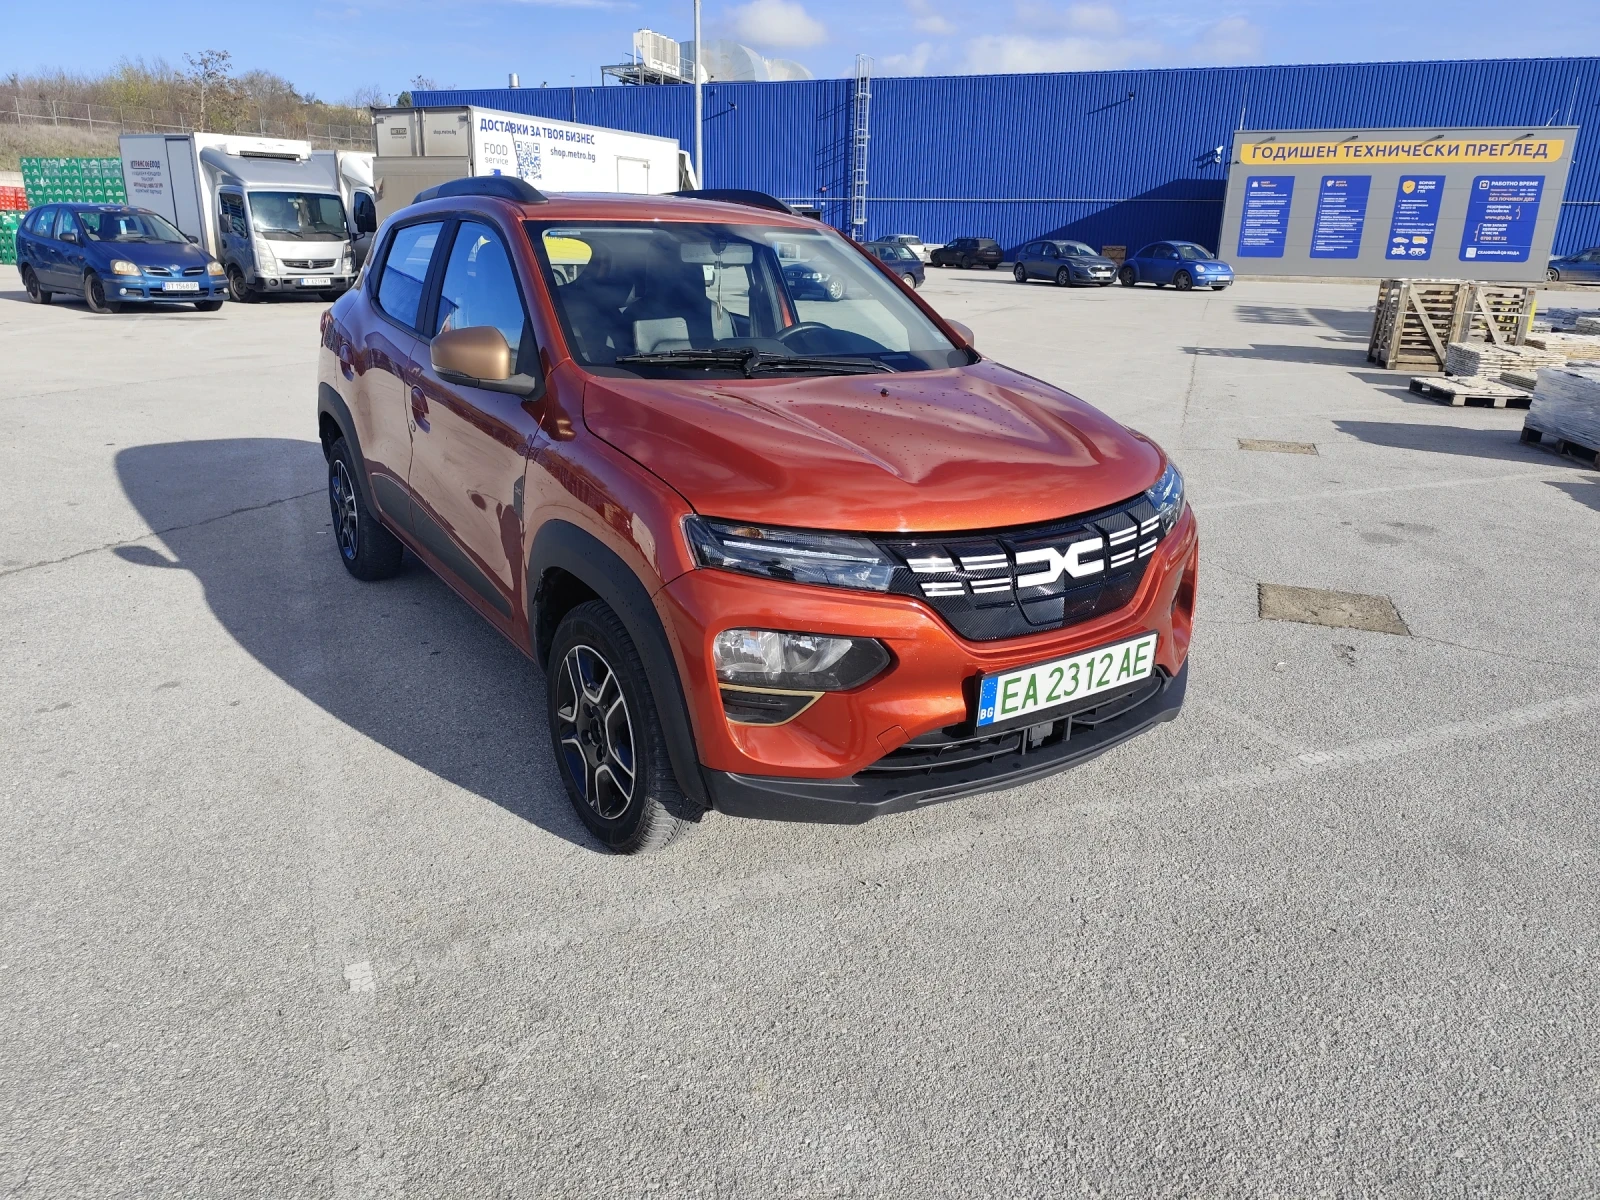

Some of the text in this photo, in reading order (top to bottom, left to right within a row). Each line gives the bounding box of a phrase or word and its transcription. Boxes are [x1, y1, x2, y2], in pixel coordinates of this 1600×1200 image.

[480, 118, 595, 145] ДОСТАВКИ ЗА ТВОЯ БИЗНЕС
[484, 143, 508, 156] FOOD
[550, 147, 596, 163] shop.metro.bg
[1252, 143, 1548, 161] ГОДИШЕН ТЕХНИЧЕСКИ ПРЕГЛЕД
[484, 156, 509, 165] service
[1001, 641, 1151, 715] EA 2312 AE
[980, 706, 994, 720] BG
